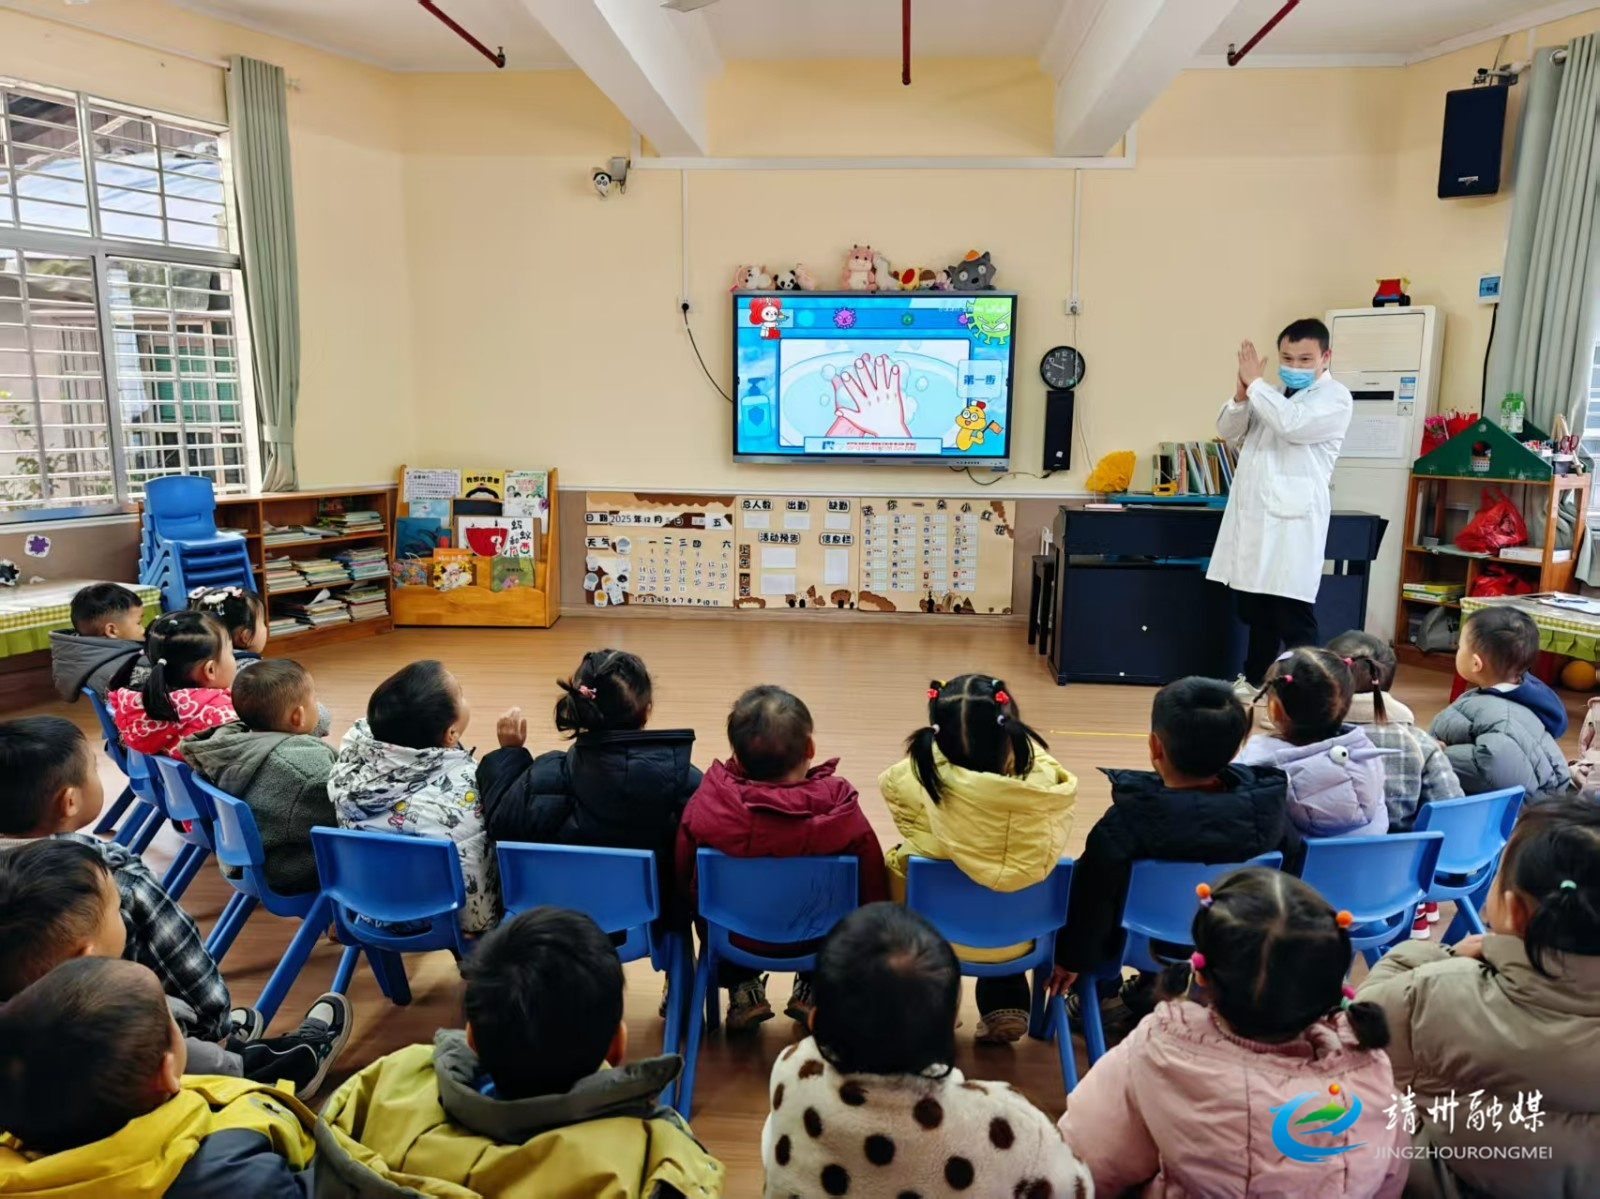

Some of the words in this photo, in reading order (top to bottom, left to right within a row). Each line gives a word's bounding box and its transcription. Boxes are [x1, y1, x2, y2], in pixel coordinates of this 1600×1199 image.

[964, 374, 996, 385] 第一步
[742, 500, 771, 510] 总人数
[787, 500, 807, 510] 出勤
[585, 514, 609, 522] 日期
[587, 537, 610, 547] 天气
[760, 532, 798, 543] 活动预告
[821, 534, 852, 544] 信息栏
[722, 540, 731, 548] 六
